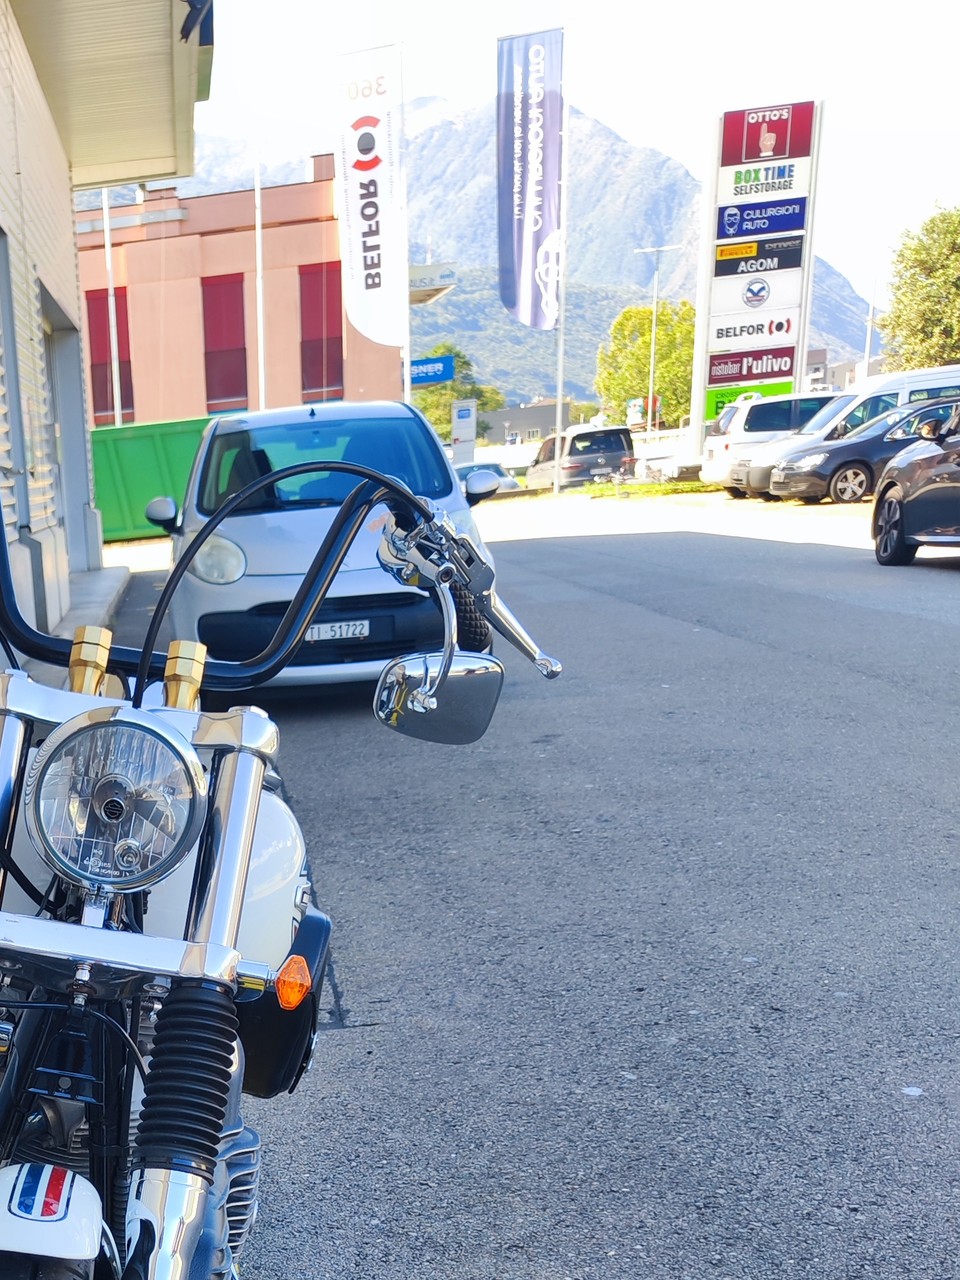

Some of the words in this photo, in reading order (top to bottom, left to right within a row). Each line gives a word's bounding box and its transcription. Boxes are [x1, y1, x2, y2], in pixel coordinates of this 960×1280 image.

[748, 109, 789, 123] OTTO'S
[734, 168, 762, 185] BOX
[764, 164, 795, 181] TIME
[733, 180, 794, 196] SELFSTORAGE
[743, 205, 800, 219] CULURGIONI
[742, 219, 769, 230] AUTO
[737, 257, 778, 273] AGOM
[716, 324, 764, 339] BELFOR
[742, 355, 791, 375] l'ulivo
[330, 623, 365, 638] 51722
